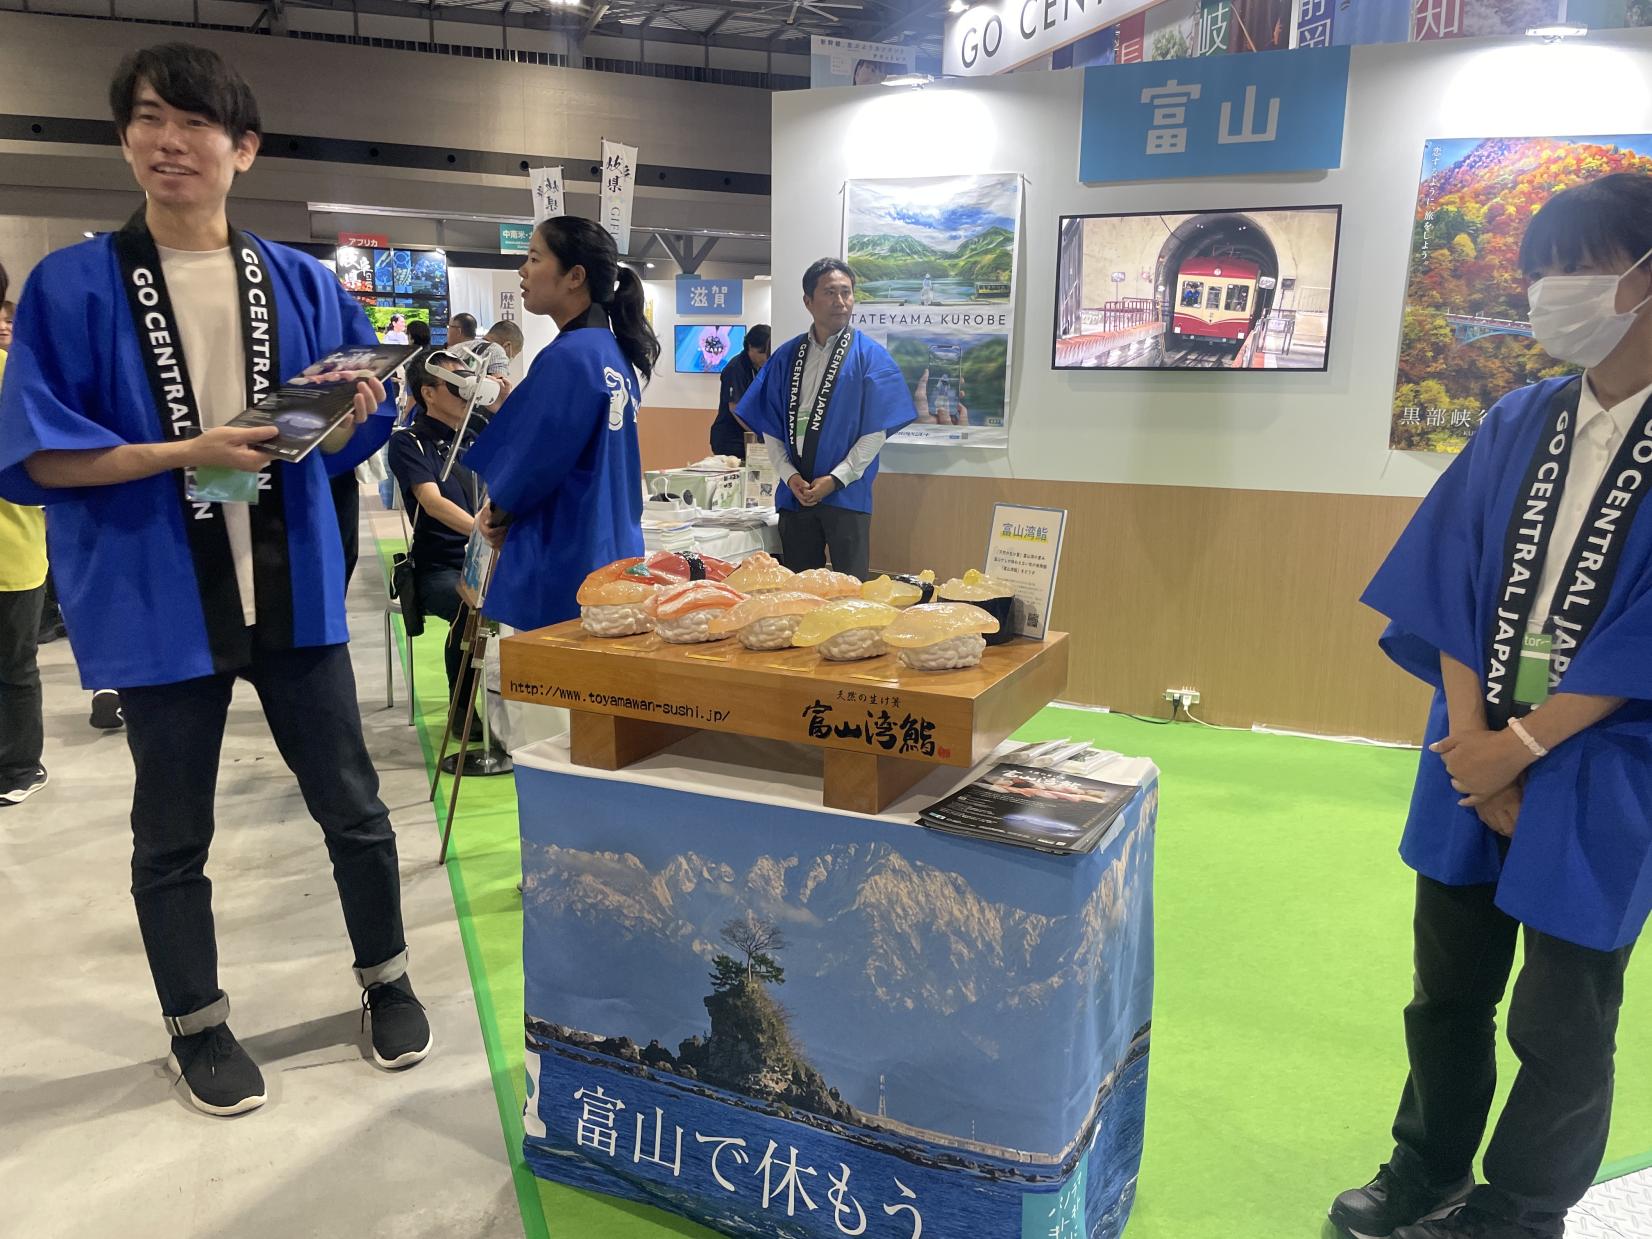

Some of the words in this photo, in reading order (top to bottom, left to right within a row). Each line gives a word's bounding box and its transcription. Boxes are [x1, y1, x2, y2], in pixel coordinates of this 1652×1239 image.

[961, 14, 1002, 69] GO
[1199, 2, 1230, 55] 岐
[1140, 79, 1281, 155] 富山
[241, 248, 263, 284] GO
[348, 237, 378, 247] アフリカ
[132, 267, 159, 307] GO
[690, 285, 728, 308] 滋賀
[840, 333, 851, 346] GO
[849, 312, 933, 326] TATEYAMA
[940, 313, 1007, 326] KUROBE
[248, 288, 271, 406] CENTRAL
[798, 343, 807, 358] GO
[145, 312, 192, 436] CENTRAL
[789, 359, 803, 409] CENTRAL
[820, 348, 845, 396] CENTRAL
[811, 396, 828, 431] JAPAN
[1549, 410, 1569, 455] GO
[1001, 522, 1049, 542] 富山湾鮨
[1504, 461, 1559, 601] CENTRAL
[1562, 469, 1642, 611] CENTRAL
[1486, 607, 1519, 705] JAPAN
[1547, 615, 1582, 688] JAPA
[510, 680, 730, 722] http://www.toyamawan-sushi.jp/
[802, 699, 936, 757] 富山湾鮨
[573, 1085, 923, 1239] 富山で休もう
